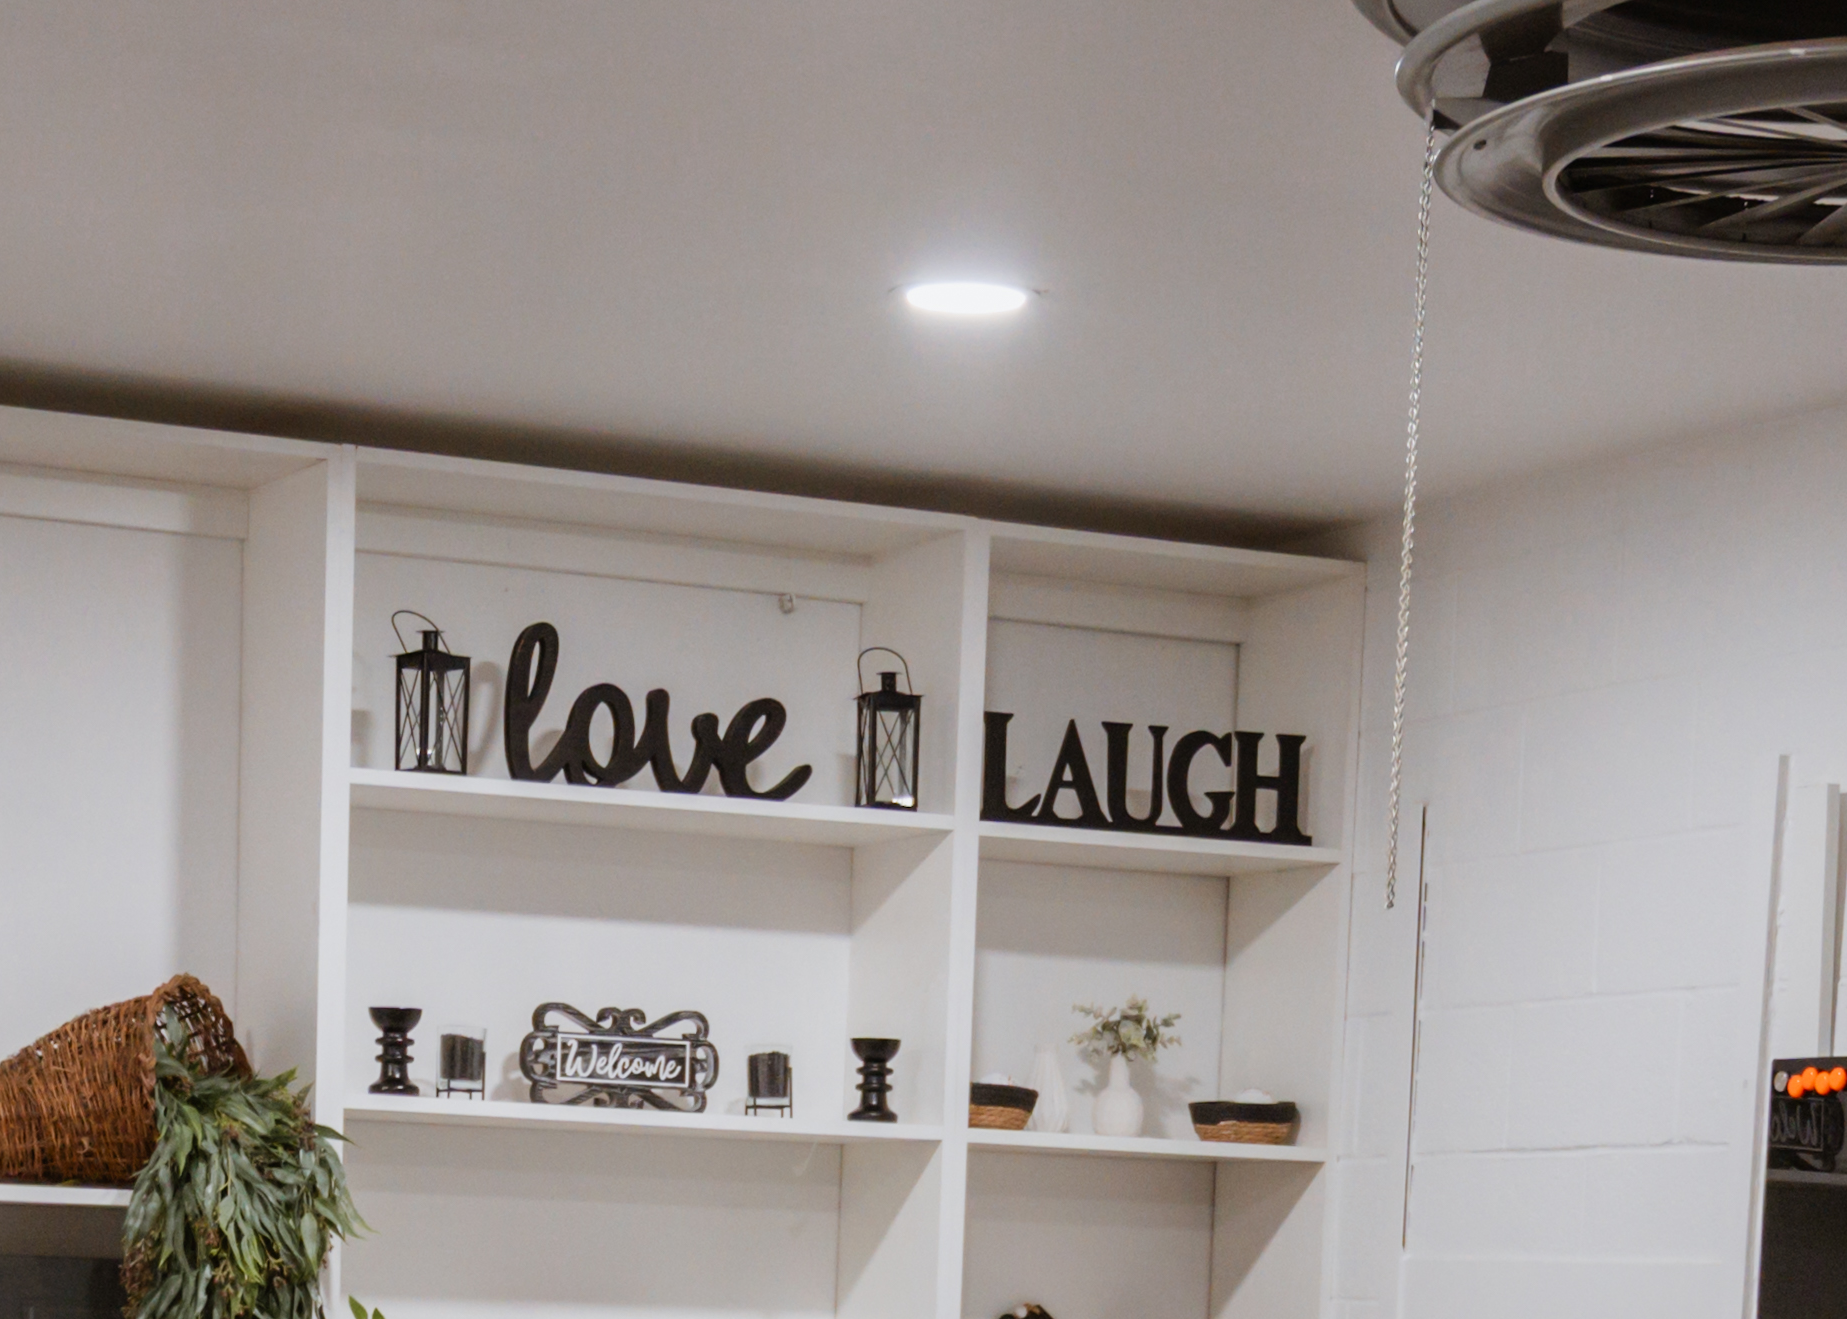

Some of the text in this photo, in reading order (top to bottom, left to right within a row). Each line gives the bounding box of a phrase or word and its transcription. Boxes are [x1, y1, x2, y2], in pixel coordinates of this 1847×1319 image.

[504, 622, 812, 801] love
[982, 711, 1312, 846] LAUGH
[565, 1039, 681, 1080] Welcome
